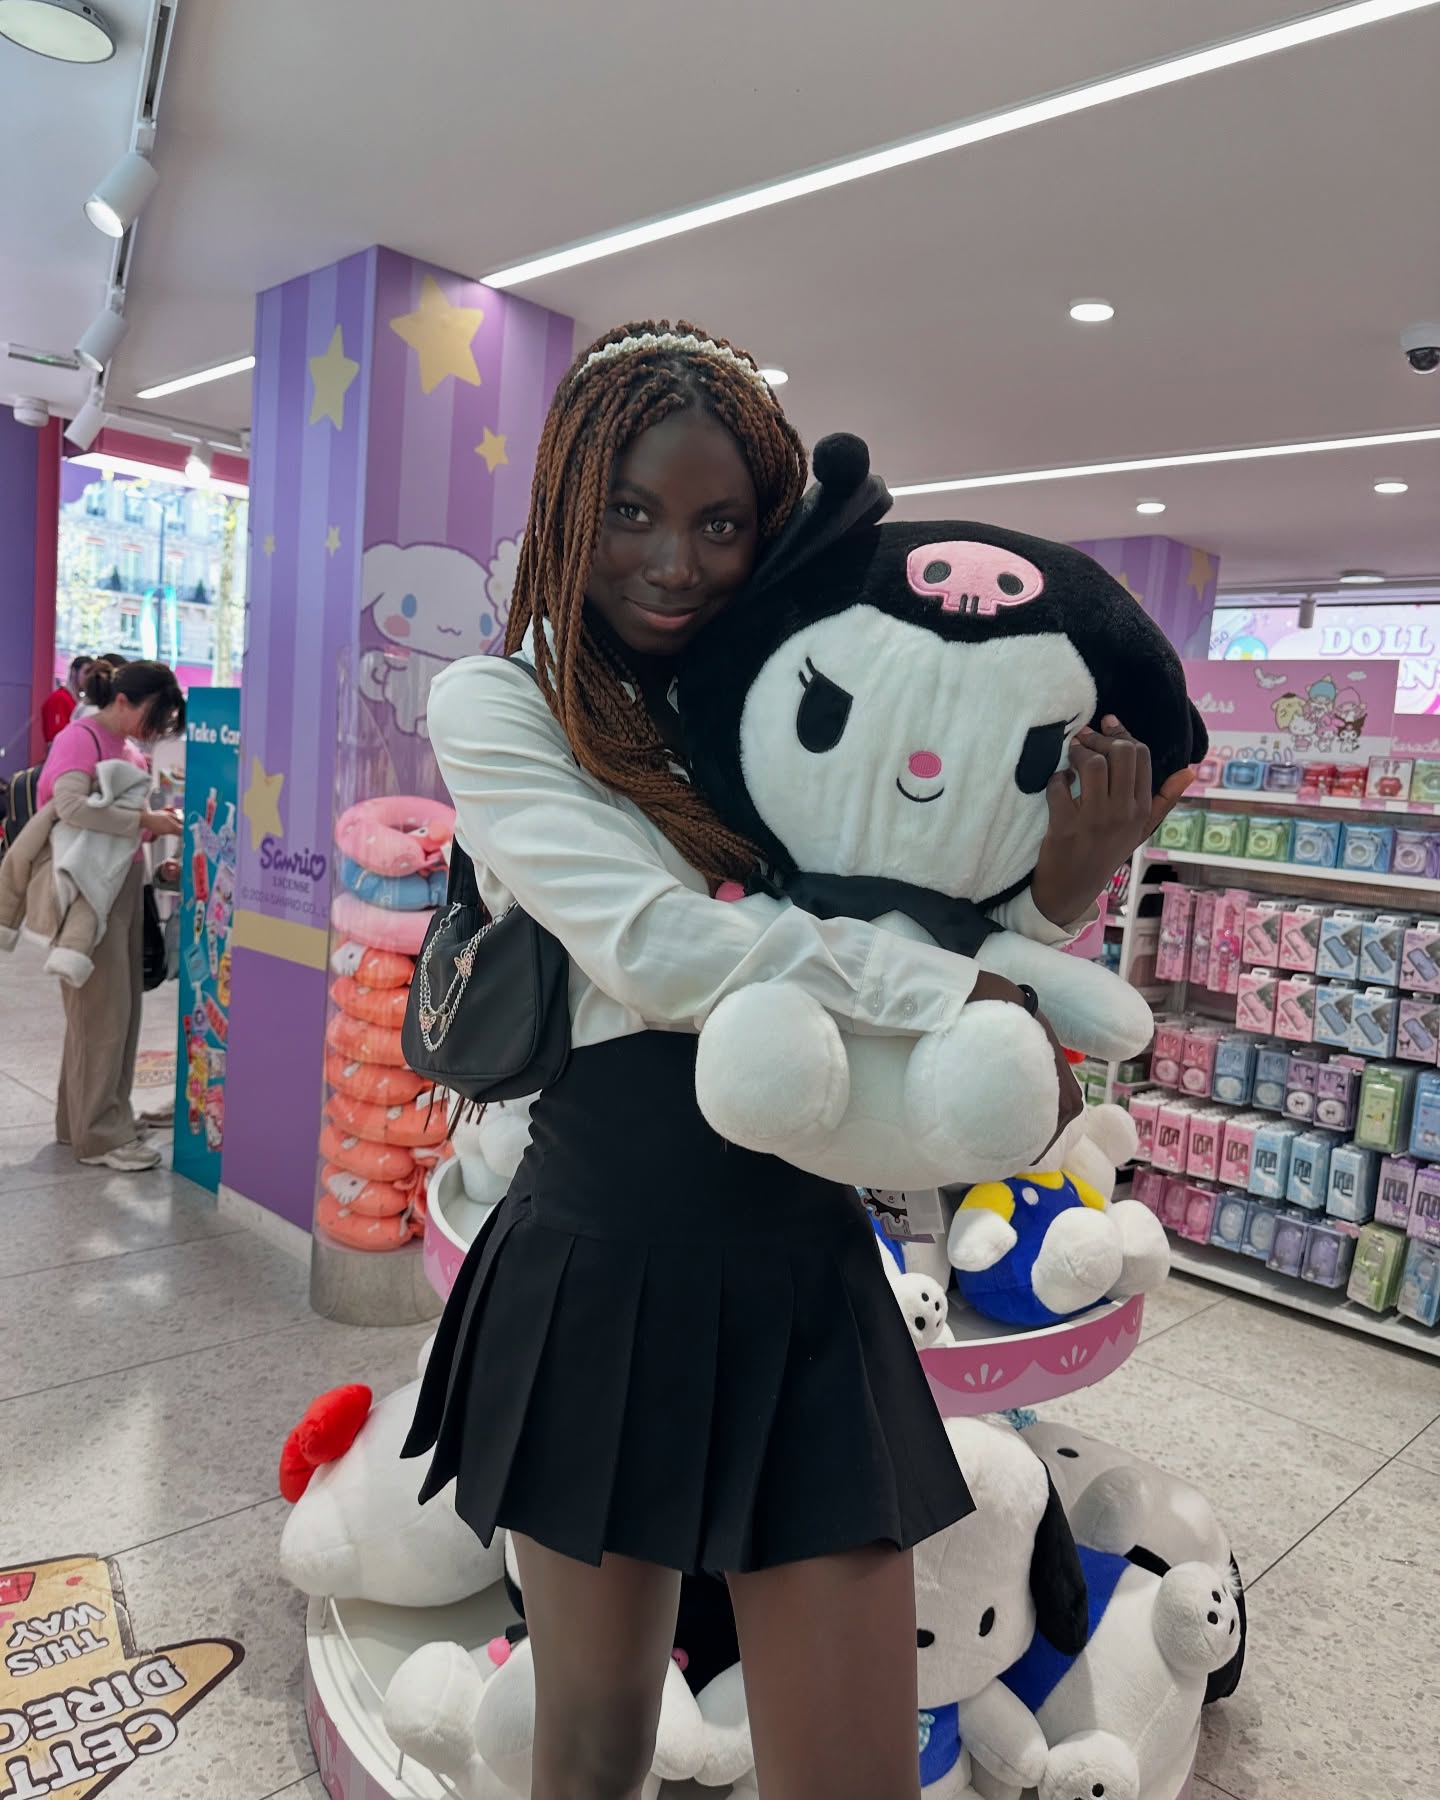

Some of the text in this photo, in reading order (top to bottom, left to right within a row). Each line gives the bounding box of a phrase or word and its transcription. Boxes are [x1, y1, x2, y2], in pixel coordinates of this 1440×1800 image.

[1319, 624, 1435, 656] DOLL
[1398, 658, 1440, 690] N
[188, 721, 241, 745] Take Car
[260, 837, 327, 882] Sanrio
[272, 876, 310, 894] LICENSE
[6, 1602, 107, 1648] WAY
[5, 1628, 109, 1677] THIS
[0, 1655, 187, 1754] DIREC
[0, 1707, 179, 1800] CETT
